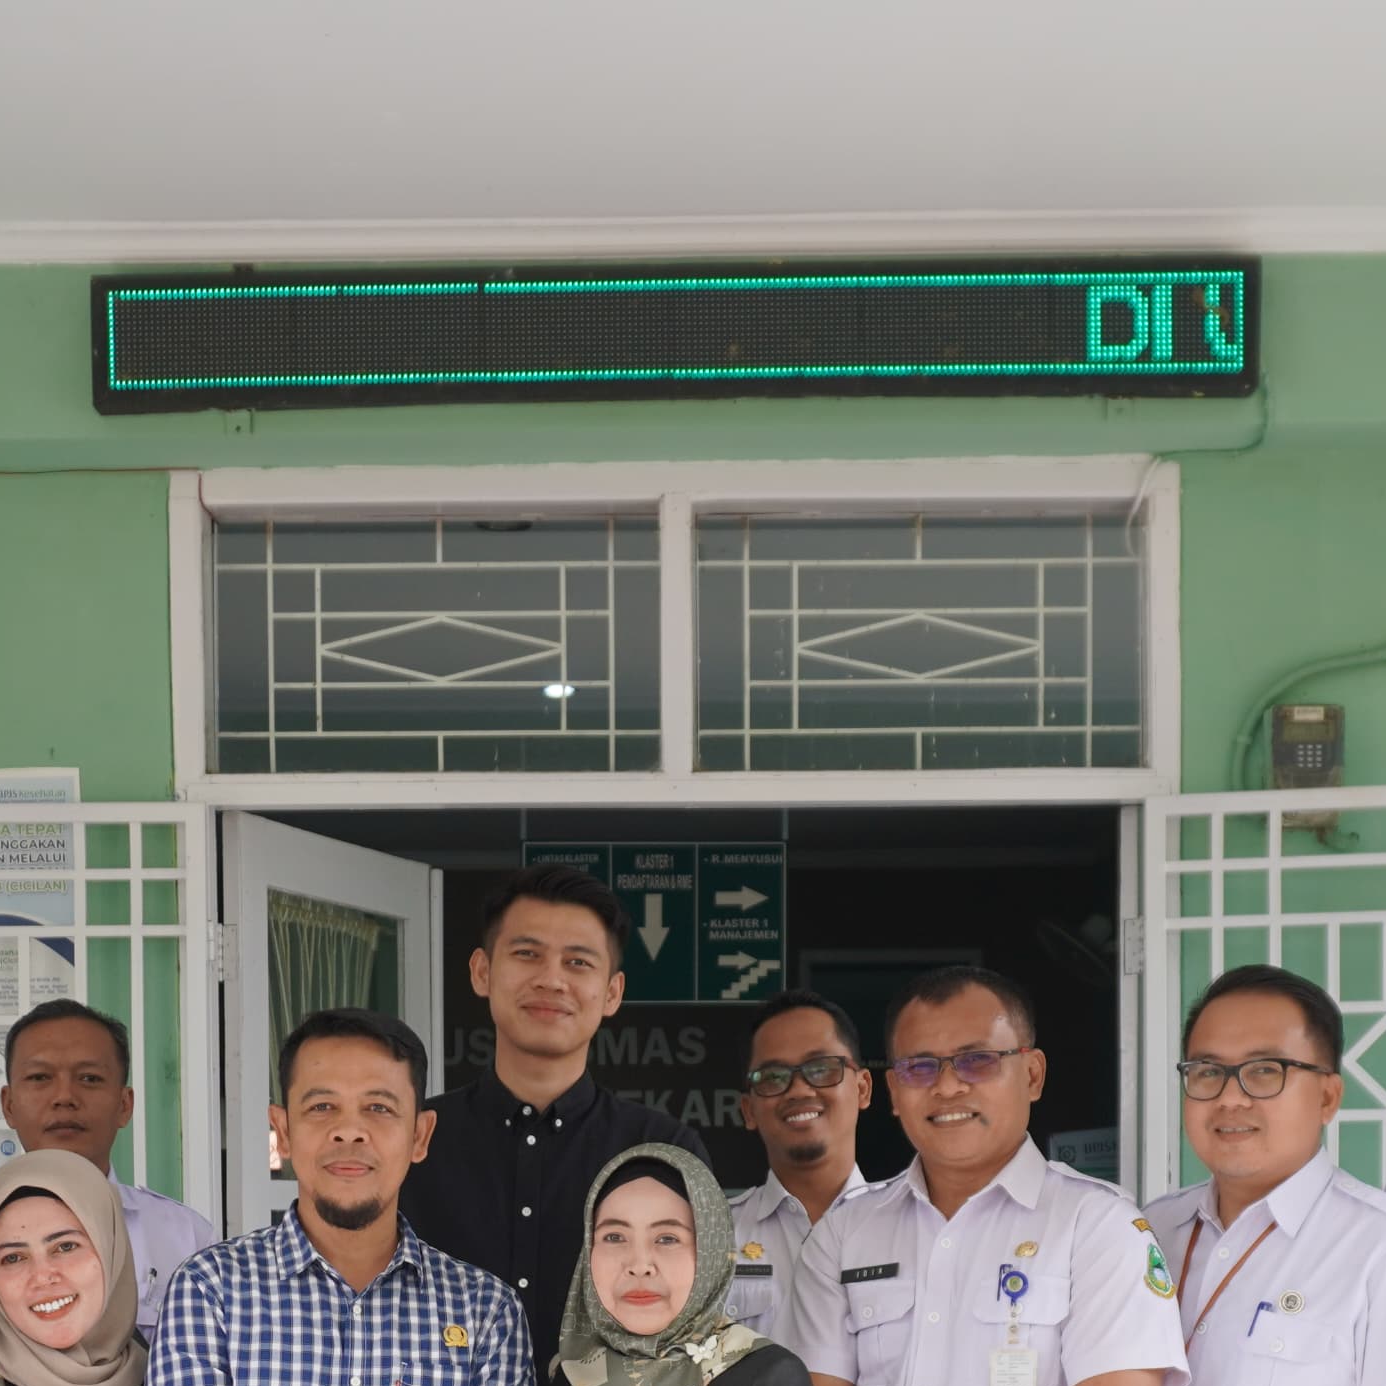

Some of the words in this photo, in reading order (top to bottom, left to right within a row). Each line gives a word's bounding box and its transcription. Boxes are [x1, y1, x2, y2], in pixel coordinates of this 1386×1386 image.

[17, 823, 65, 836] TEPAT
[9, 853, 66, 863] MELALUI
[634, 854, 669, 869] KLASTER
